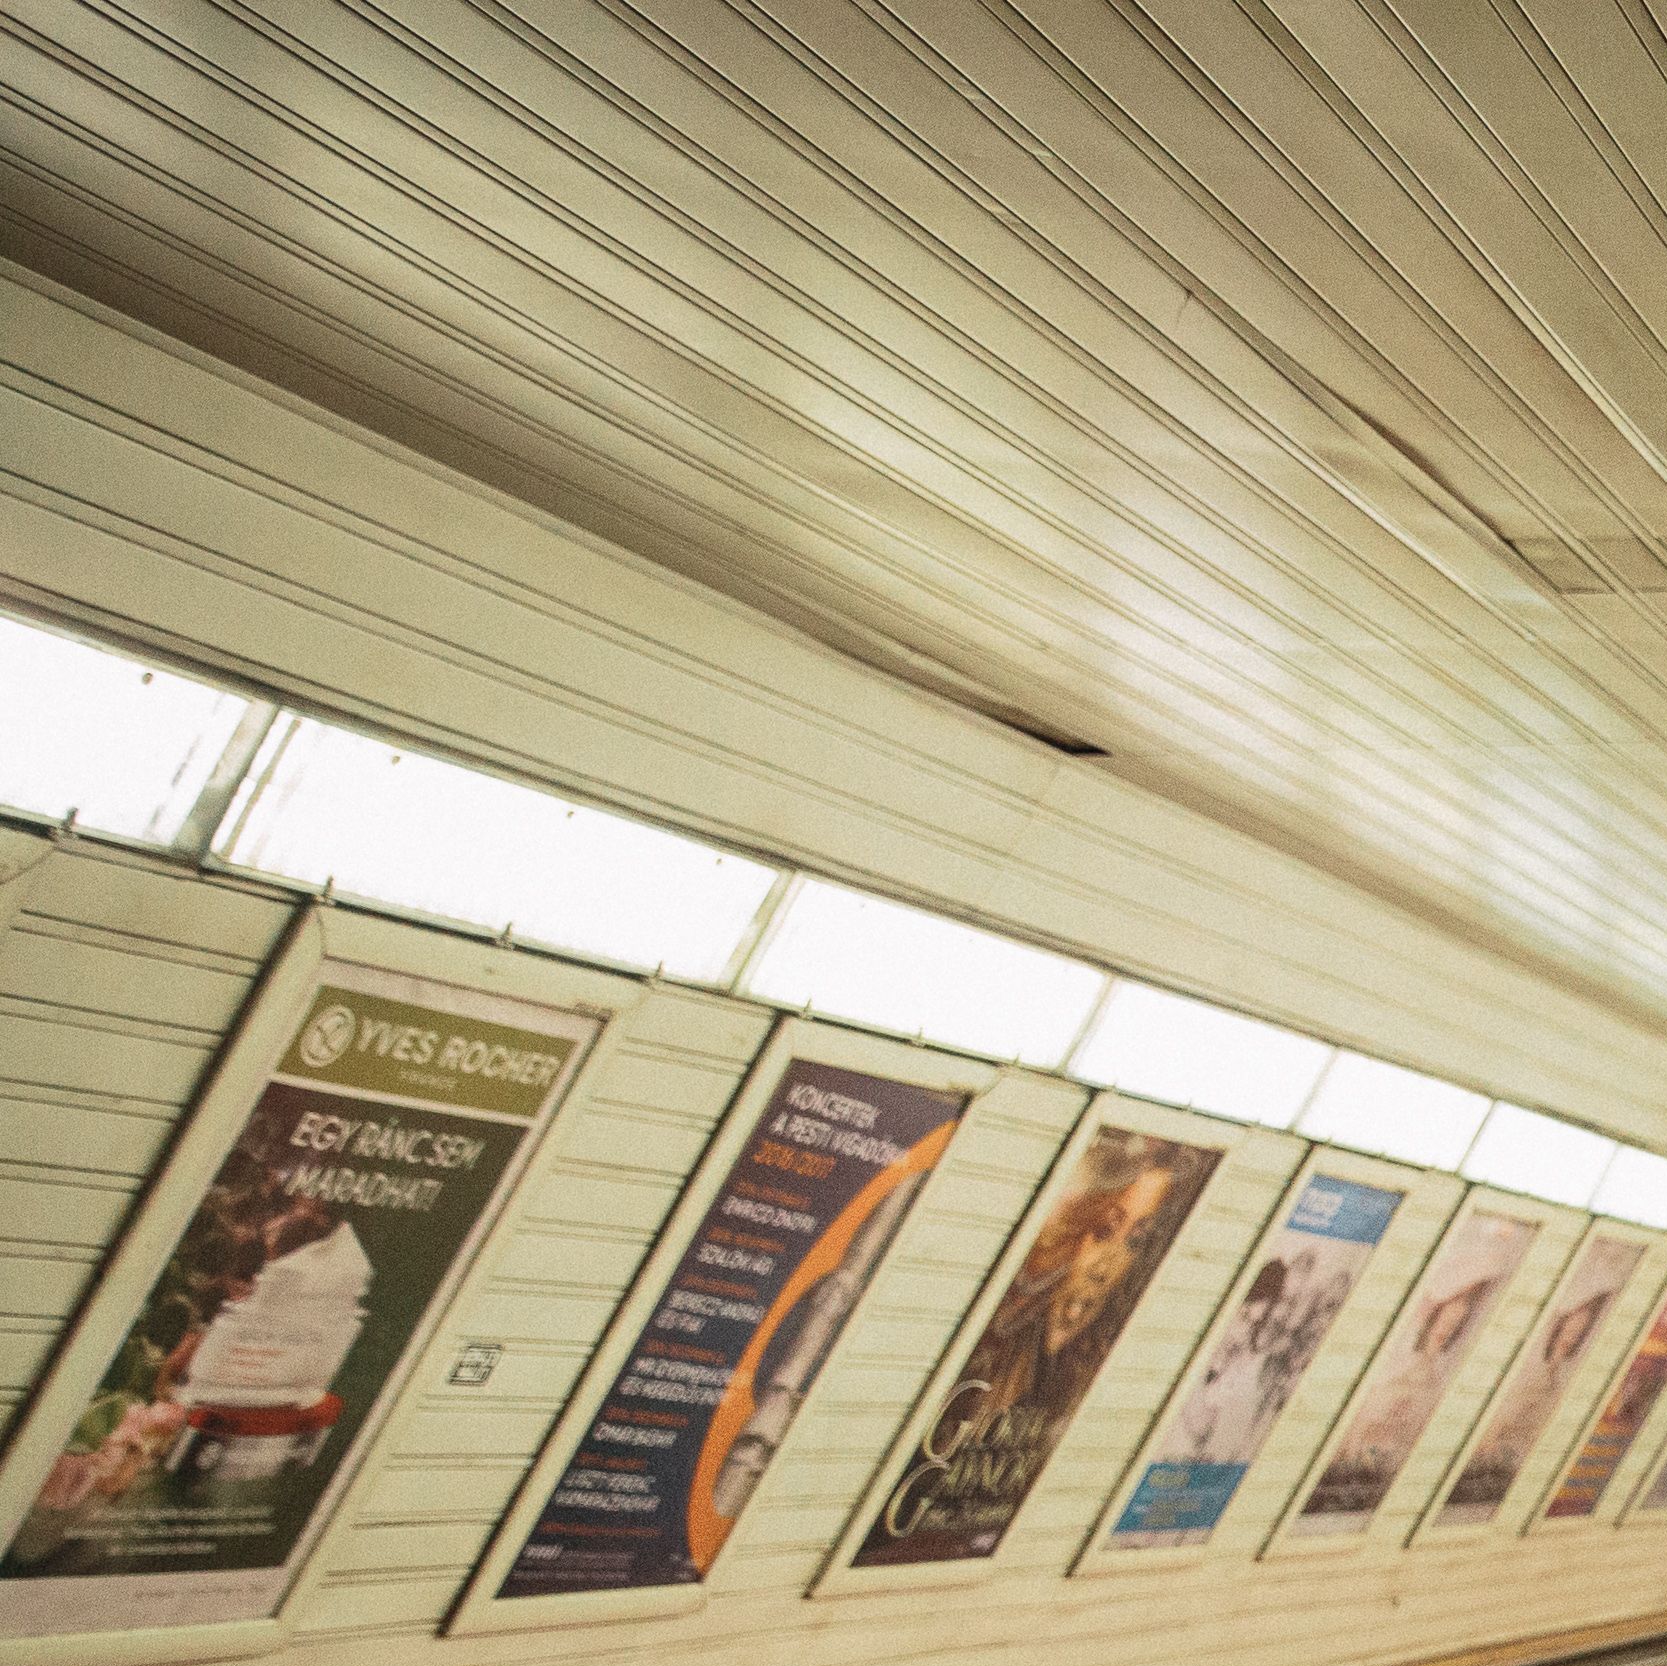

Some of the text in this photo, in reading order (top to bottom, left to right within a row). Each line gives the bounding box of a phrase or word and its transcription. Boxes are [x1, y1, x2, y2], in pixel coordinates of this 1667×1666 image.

[356, 1018, 440, 1065] YVES
[437, 1035, 561, 1086] ROCHER
[785, 1081, 882, 1130] KONCERTEK
[289, 1110, 362, 1153] EGY
